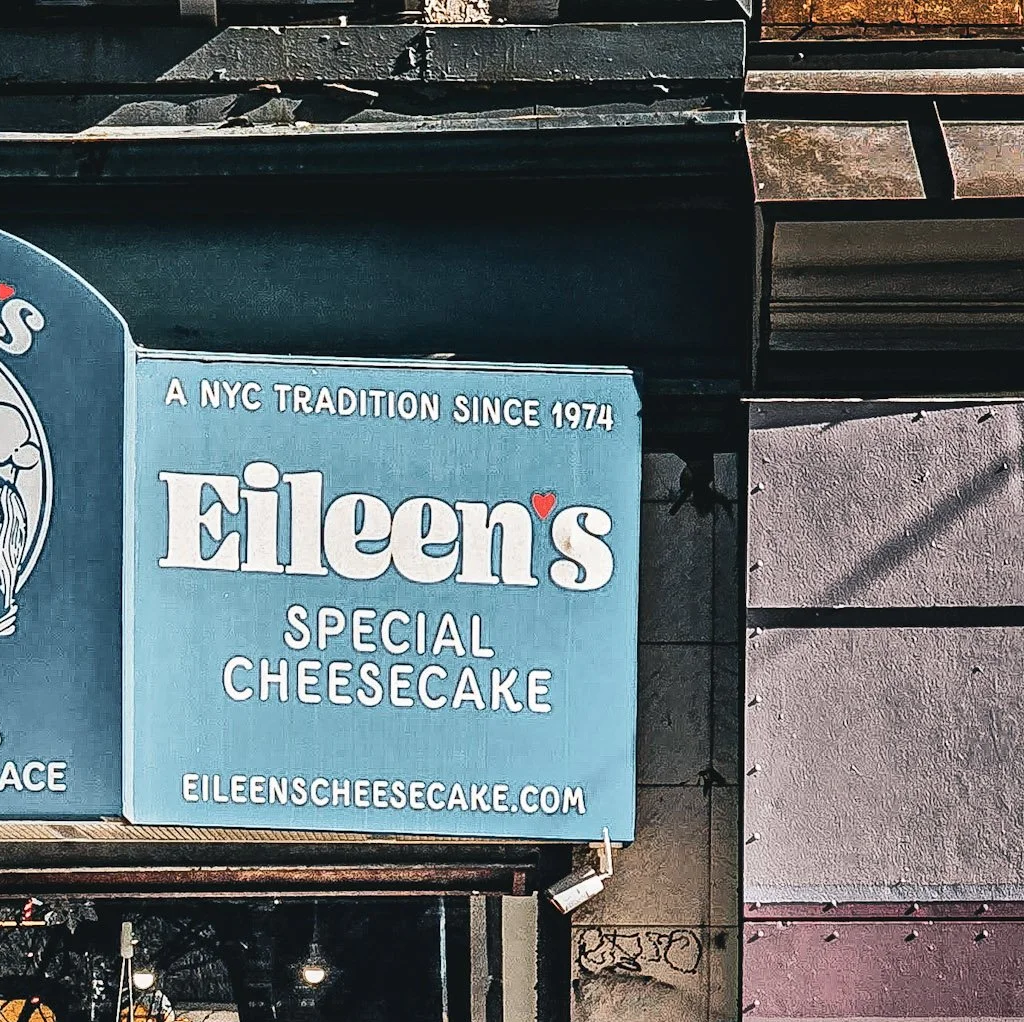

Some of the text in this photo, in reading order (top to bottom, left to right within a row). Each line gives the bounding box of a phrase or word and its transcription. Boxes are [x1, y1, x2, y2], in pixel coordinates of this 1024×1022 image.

[165, 378, 615, 432] A NYC TRADITION SINCE 1974
[158, 460, 615, 591] Eileen's
[283, 604, 495, 659] SPECIAL
[222, 655, 553, 714] CHEESECAKE
[181, 772, 587, 815] EILEENSCHEESECAKE.COM
